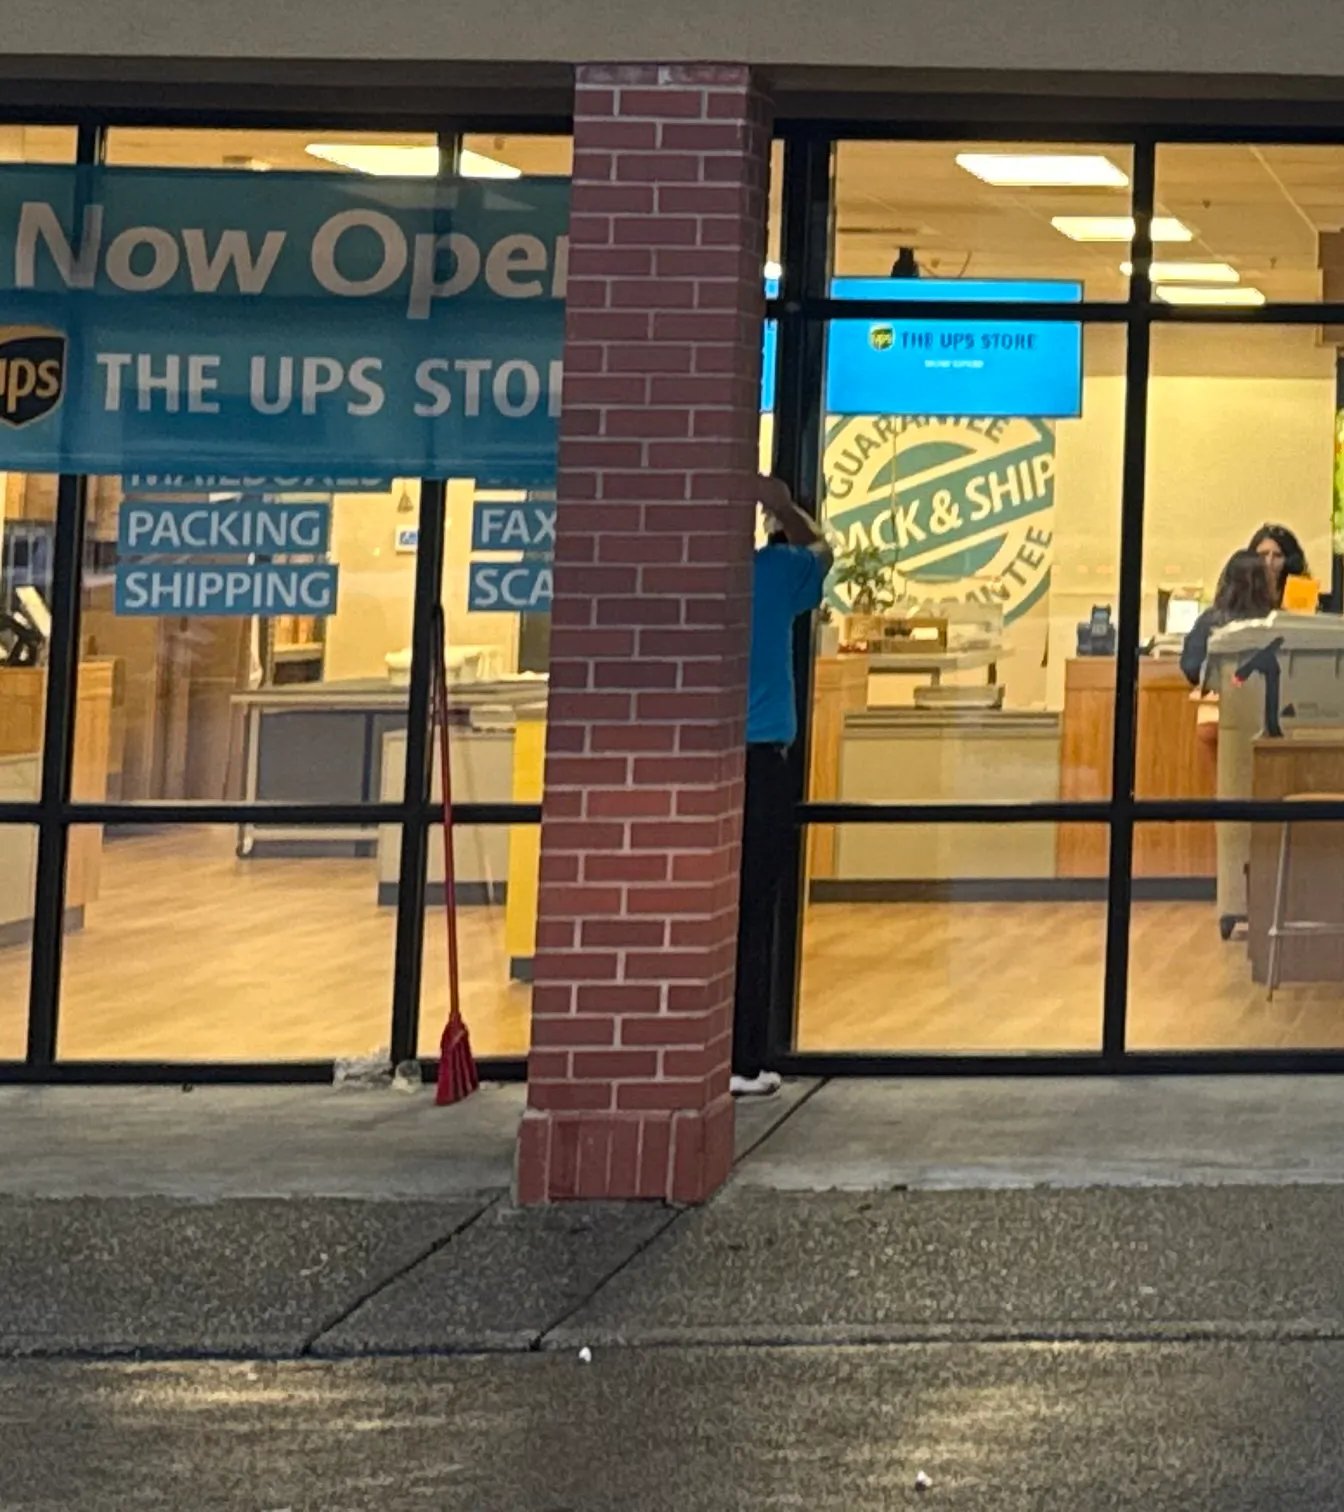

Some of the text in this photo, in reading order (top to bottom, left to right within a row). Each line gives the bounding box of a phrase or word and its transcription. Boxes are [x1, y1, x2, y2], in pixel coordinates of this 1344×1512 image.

[14, 201, 570, 320] Now Ope
[0, 357, 61, 413] ps
[96, 352, 221, 414] THE
[249, 355, 385, 416] UPS
[929, 489, 963, 534] &
[965, 452, 1054, 522] SHIP
[126, 509, 321, 548] PACKING
[123, 570, 332, 609] SHIPPING
[474, 568, 554, 607] SCA
